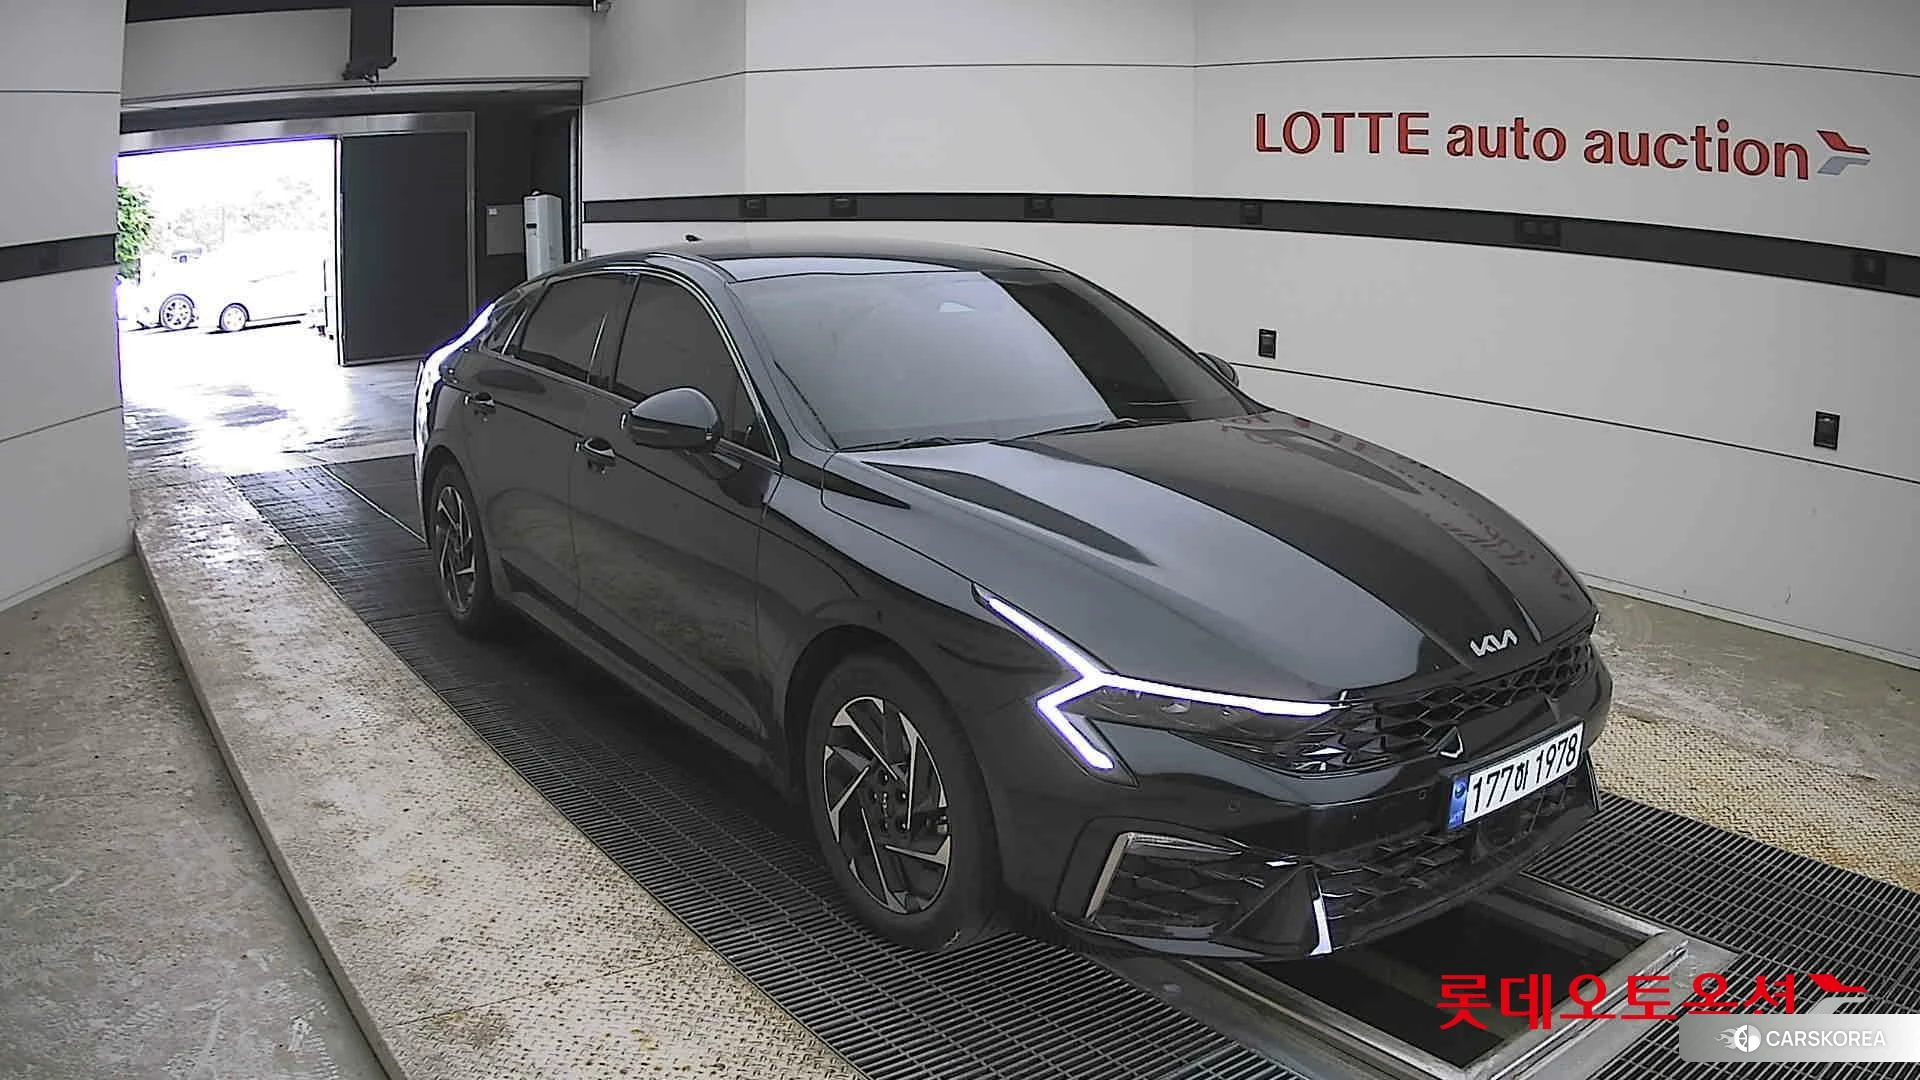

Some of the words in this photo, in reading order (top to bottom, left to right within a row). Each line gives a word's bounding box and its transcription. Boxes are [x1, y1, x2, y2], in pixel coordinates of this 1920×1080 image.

[1255, 111, 1430, 155] LOTTE
[1446, 117, 1567, 161] auto
[1583, 119, 1810, 180] auction
[1470, 629, 1518, 657] KIA
[1536, 733, 1578, 784] 1978
